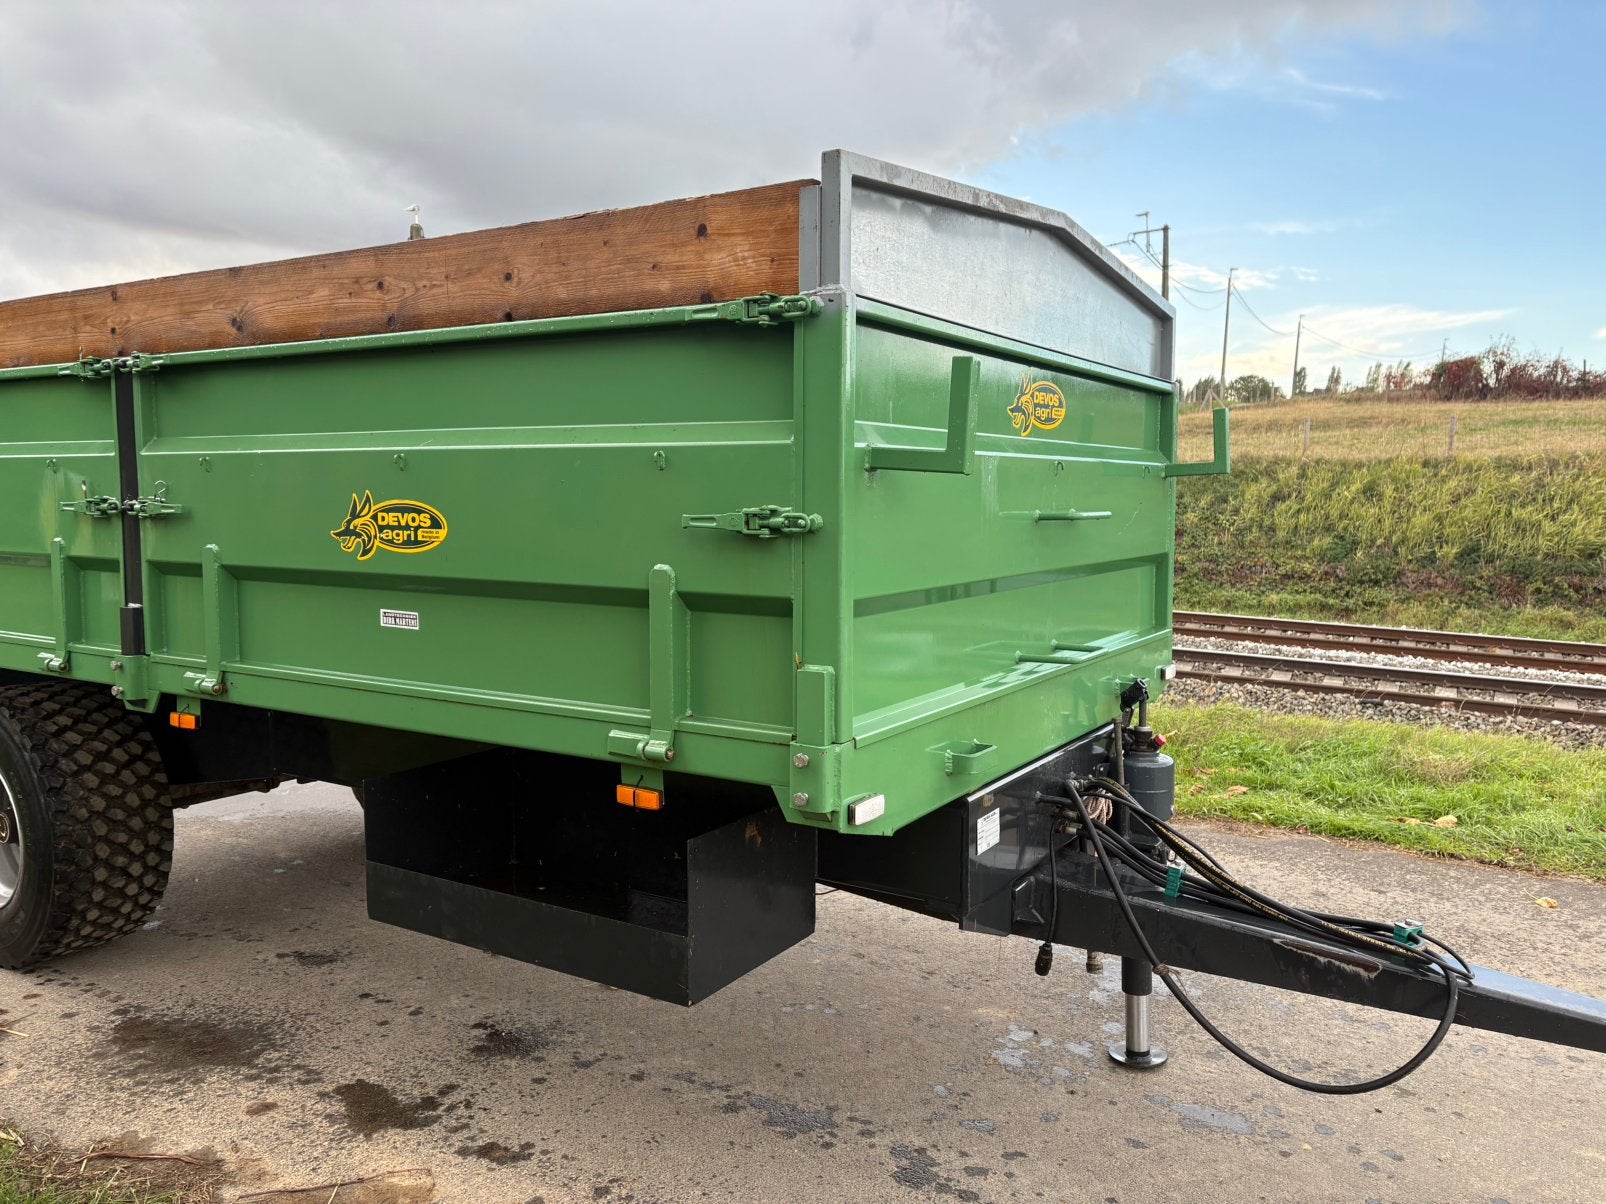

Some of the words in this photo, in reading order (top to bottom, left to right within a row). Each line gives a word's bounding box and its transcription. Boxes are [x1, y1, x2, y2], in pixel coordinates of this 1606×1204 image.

[1034, 392, 1060, 406] DEVOS
[1036, 406, 1052, 420] agri
[377, 512, 431, 527] DEVOS
[382, 528, 415, 543] agri
